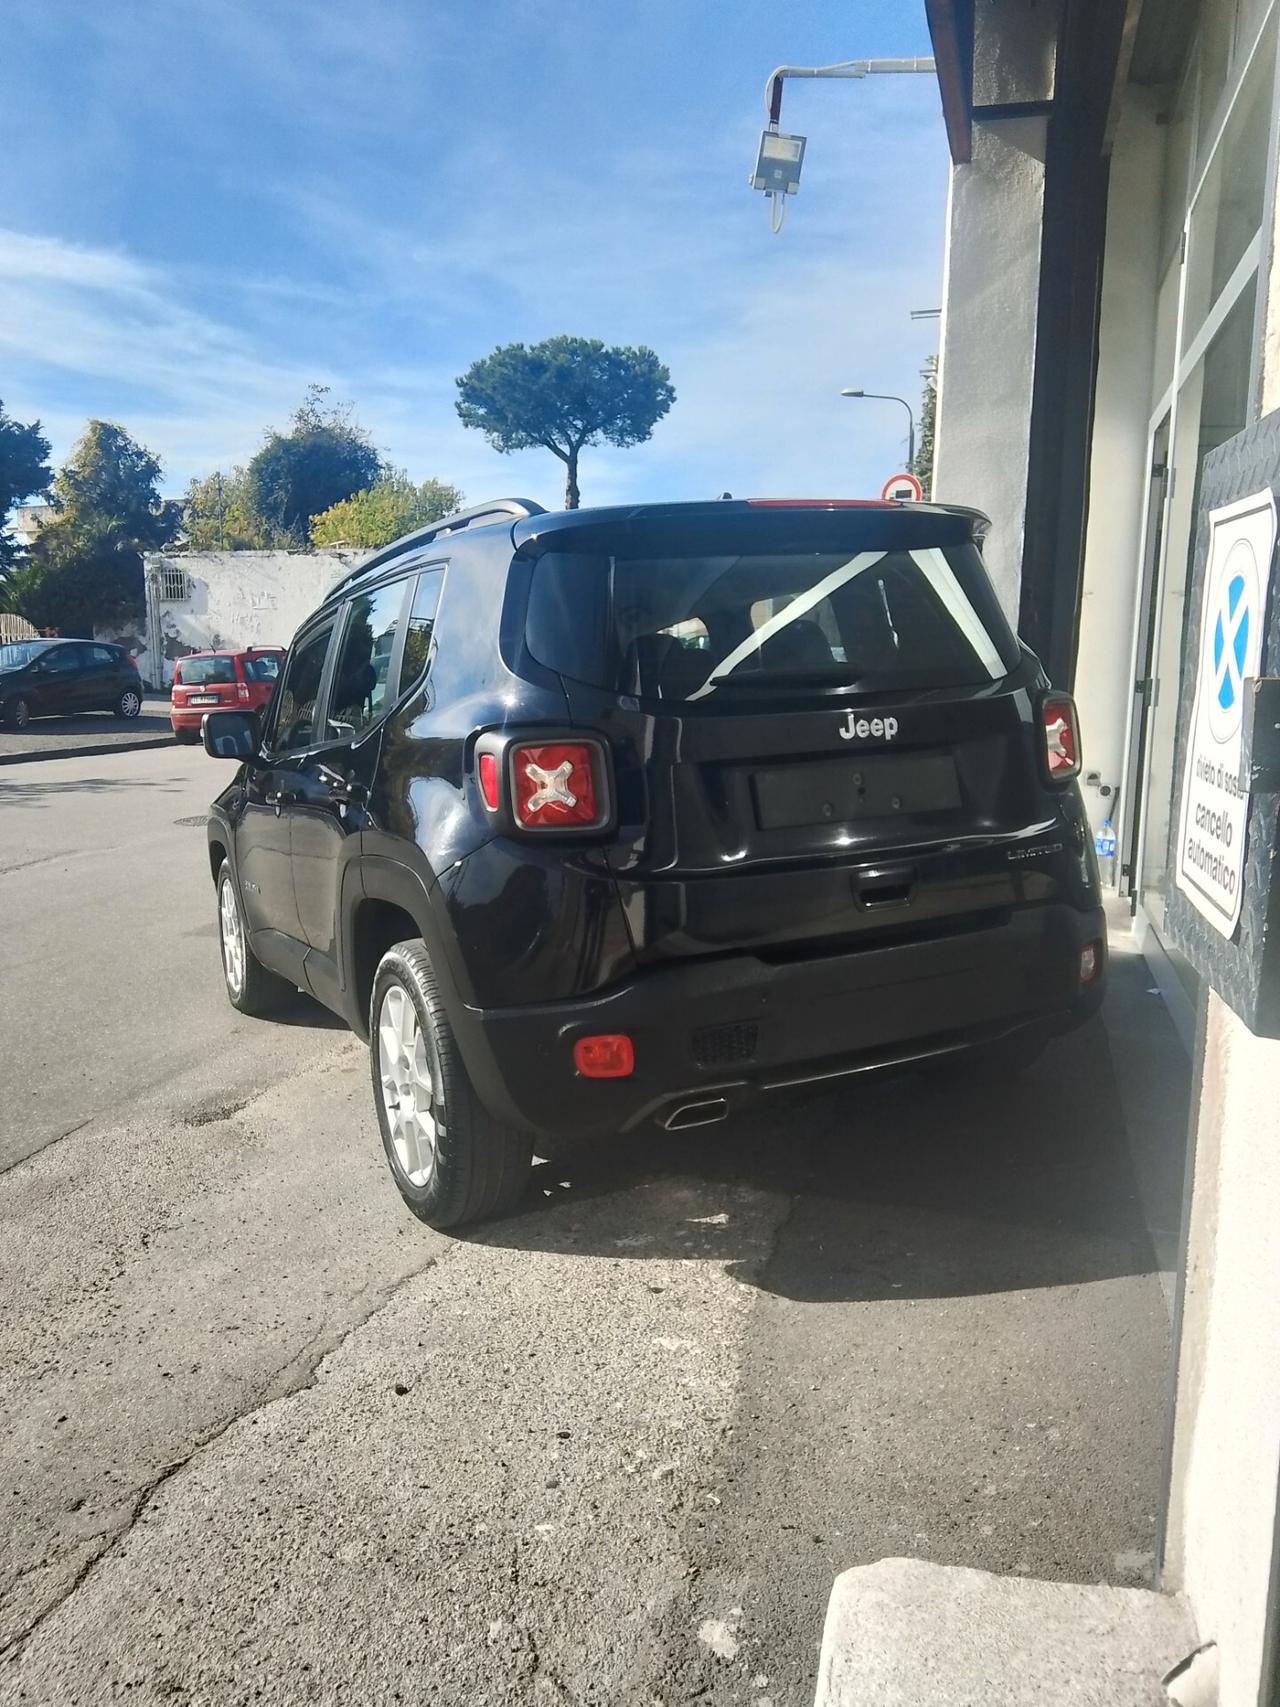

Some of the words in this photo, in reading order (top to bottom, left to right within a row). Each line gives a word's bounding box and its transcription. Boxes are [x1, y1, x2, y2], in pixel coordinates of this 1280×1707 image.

[839, 713, 898, 740] Jeep
[1217, 762, 1224, 789] di
[1196, 803, 1232, 848] cancello
[1188, 838, 1235, 895] automatico
